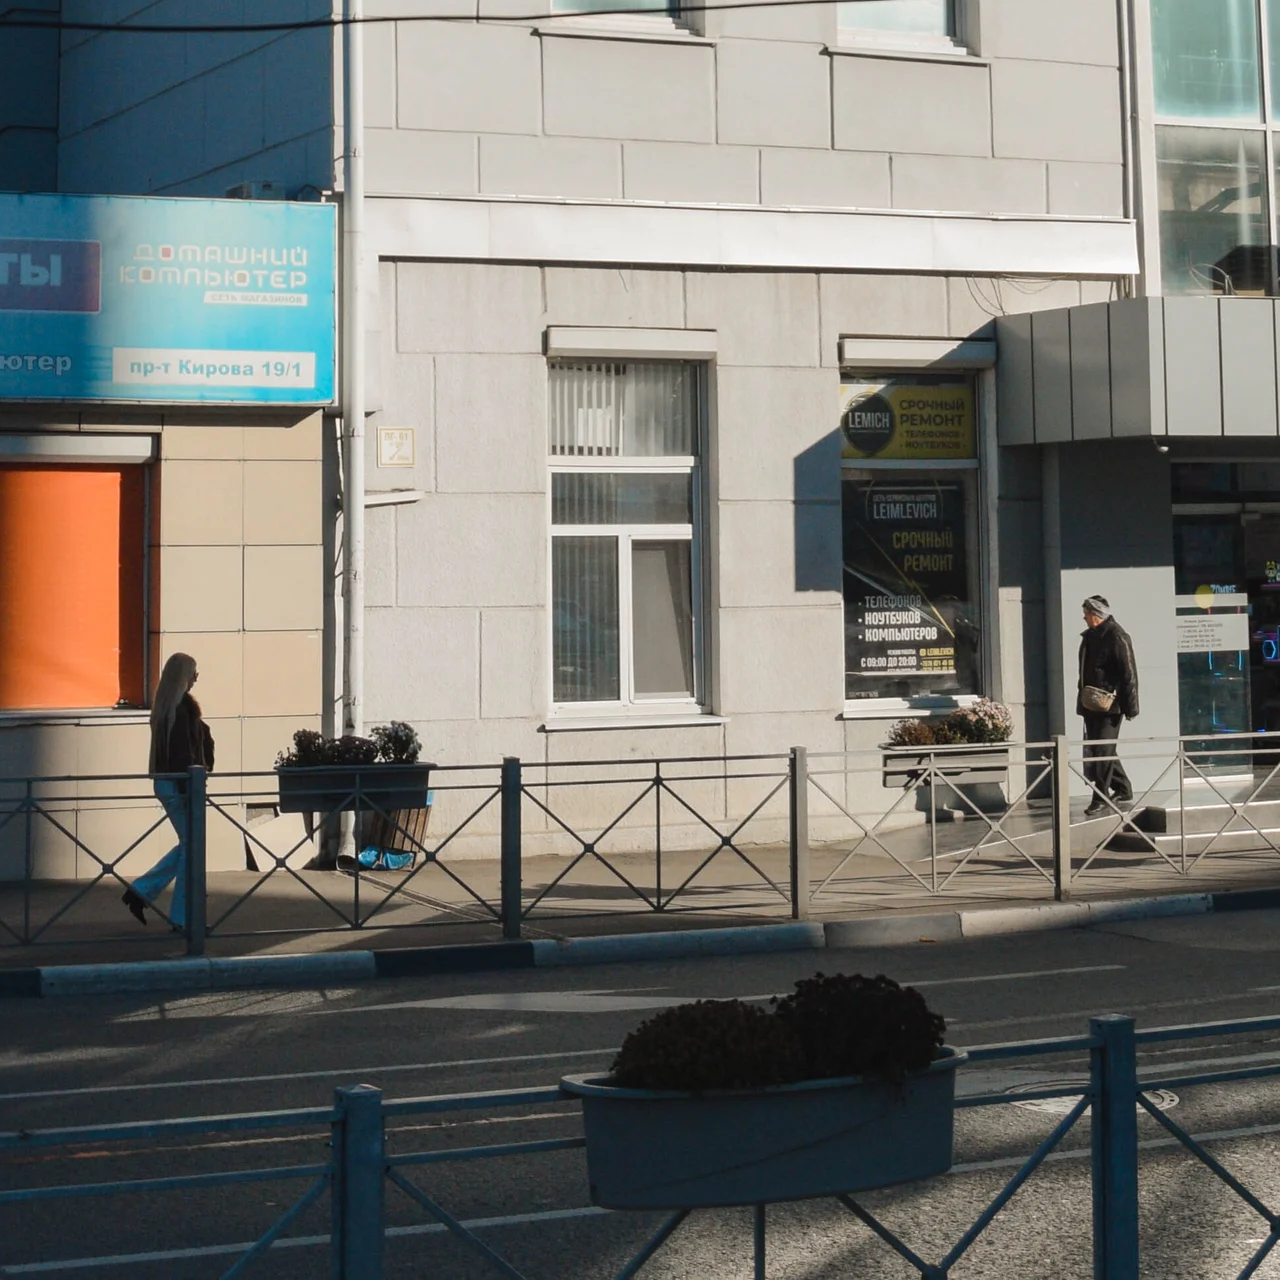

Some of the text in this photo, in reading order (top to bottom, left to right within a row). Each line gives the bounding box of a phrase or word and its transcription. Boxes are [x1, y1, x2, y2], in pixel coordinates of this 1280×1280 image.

[133, 243, 308, 266] ДОМАШНИЙ
[119, 265, 307, 289] КОМПЬЮТЕР
[211, 293, 303, 304] СЕТЬ МАГАЗИНОВ
[130, 358, 302, 380] пр-т Кирова 19/1
[899, 398, 965, 411] СРОЧНЫЙ
[848, 412, 890, 428] LEMICH
[899, 414, 965, 426] РЕМОНТ
[873, 503, 937, 519] LEIMLEVICH
[892, 527, 953, 549] СРОЧНЫЙ
[904, 554, 954, 572] РЕМОНТ
[864, 595, 922, 609] ТЕЛЕФОНОВ
[864, 611, 921, 625] НОУТБУКОВ
[865, 626, 938, 642] КОМПЬЮТЕРОВ
